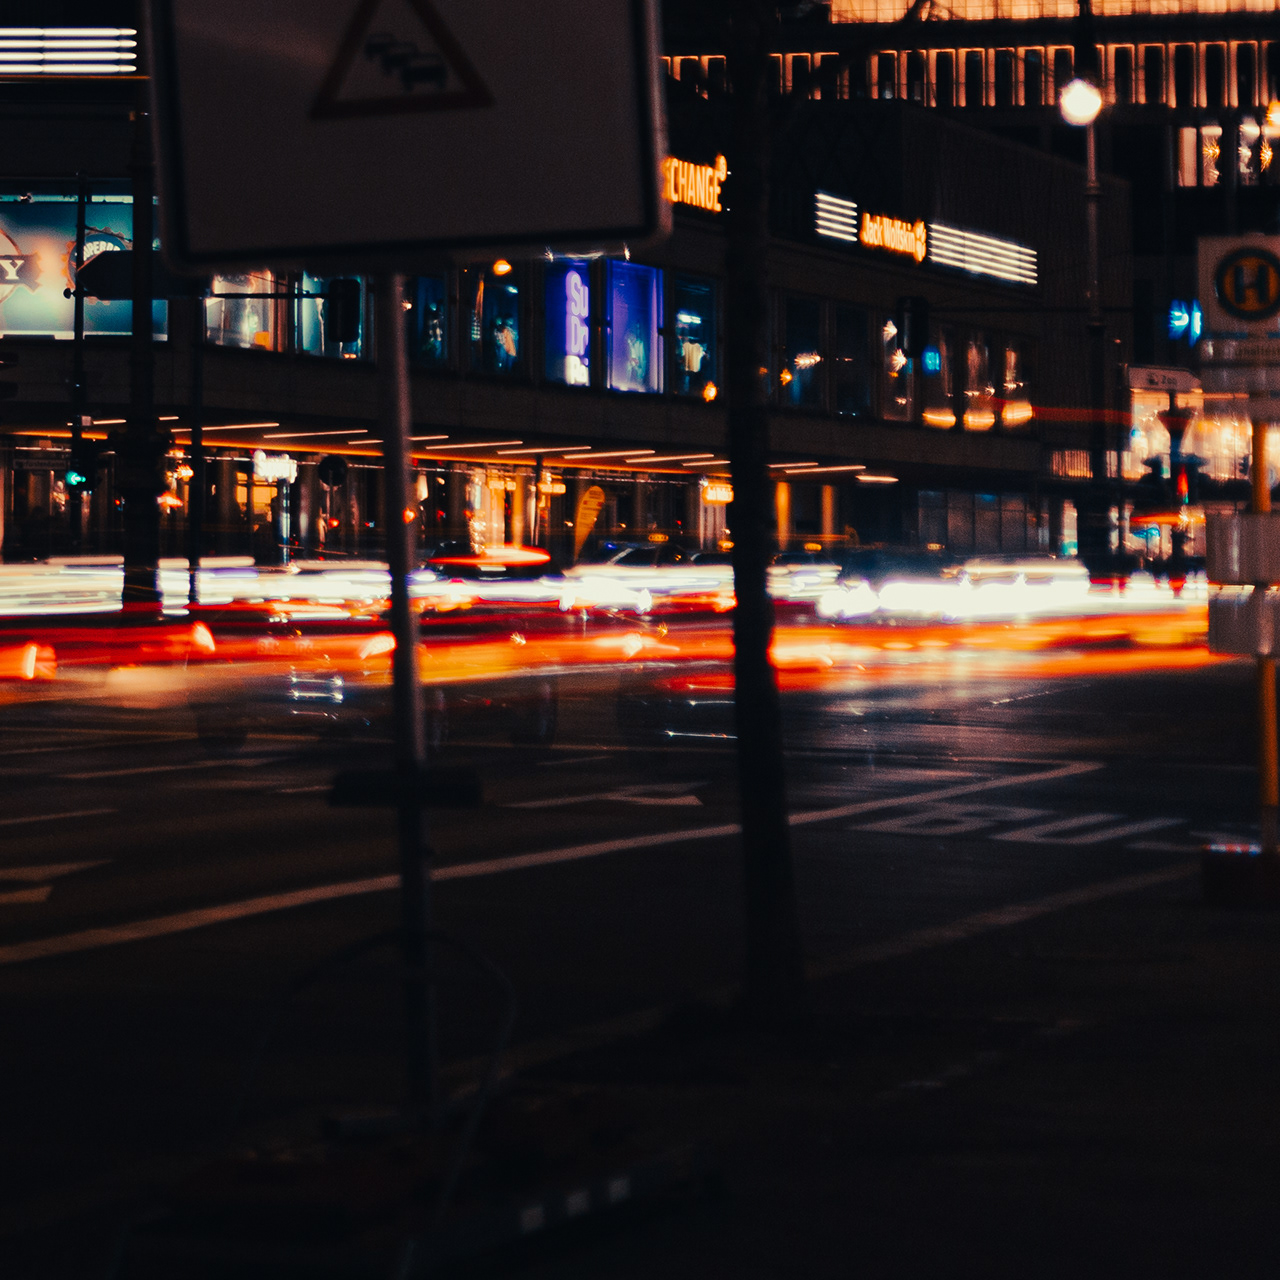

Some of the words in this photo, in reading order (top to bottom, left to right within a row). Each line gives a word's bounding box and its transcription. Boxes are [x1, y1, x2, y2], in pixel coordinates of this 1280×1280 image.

[860, 213, 883, 246] Jack
[882, 217, 915, 253] Wolfskin
[1234, 264, 1269, 304] H
